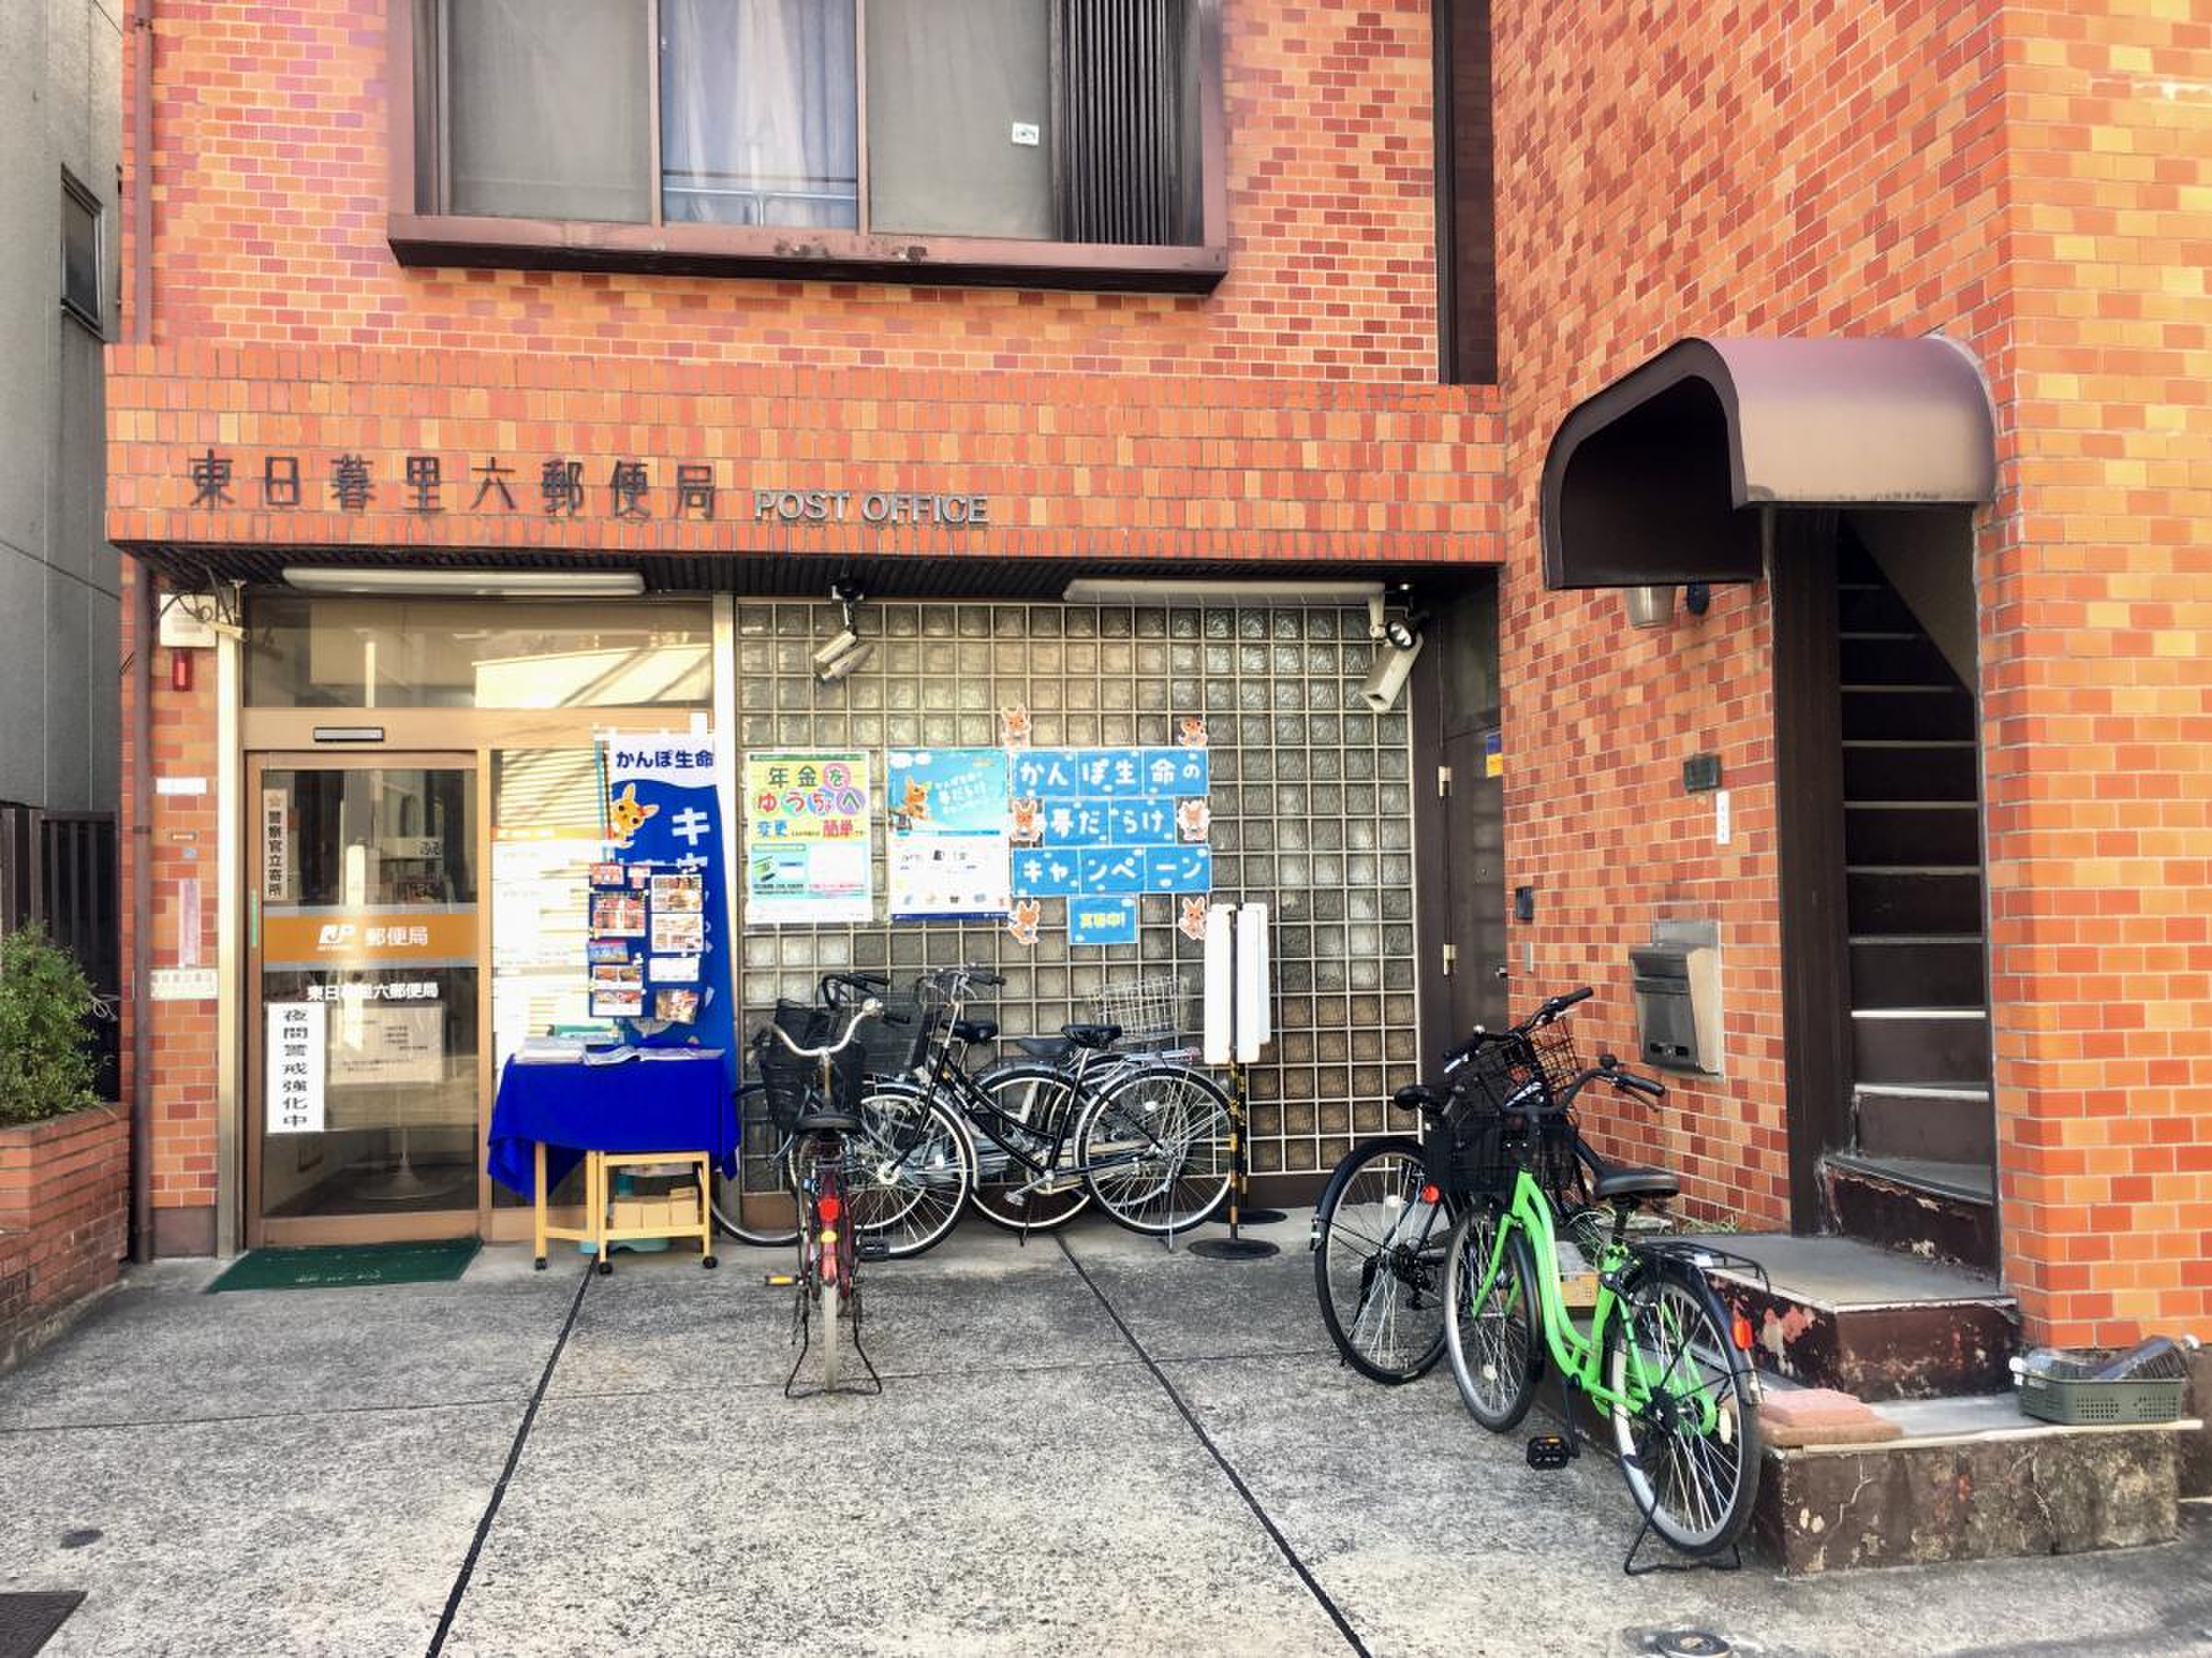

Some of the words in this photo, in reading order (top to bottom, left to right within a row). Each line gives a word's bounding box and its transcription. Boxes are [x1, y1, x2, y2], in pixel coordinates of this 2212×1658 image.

[191, 449, 715, 519] 東日暮里六郵便局
[753, 489, 850, 522] POST
[862, 492, 989, 524] OFFICE
[615, 750, 716, 769] かんぽ生命
[1019, 758, 1201, 786] かんぽ生命の
[768, 765, 844, 788] 年金を
[1022, 858, 1202, 883] キャンペーン
